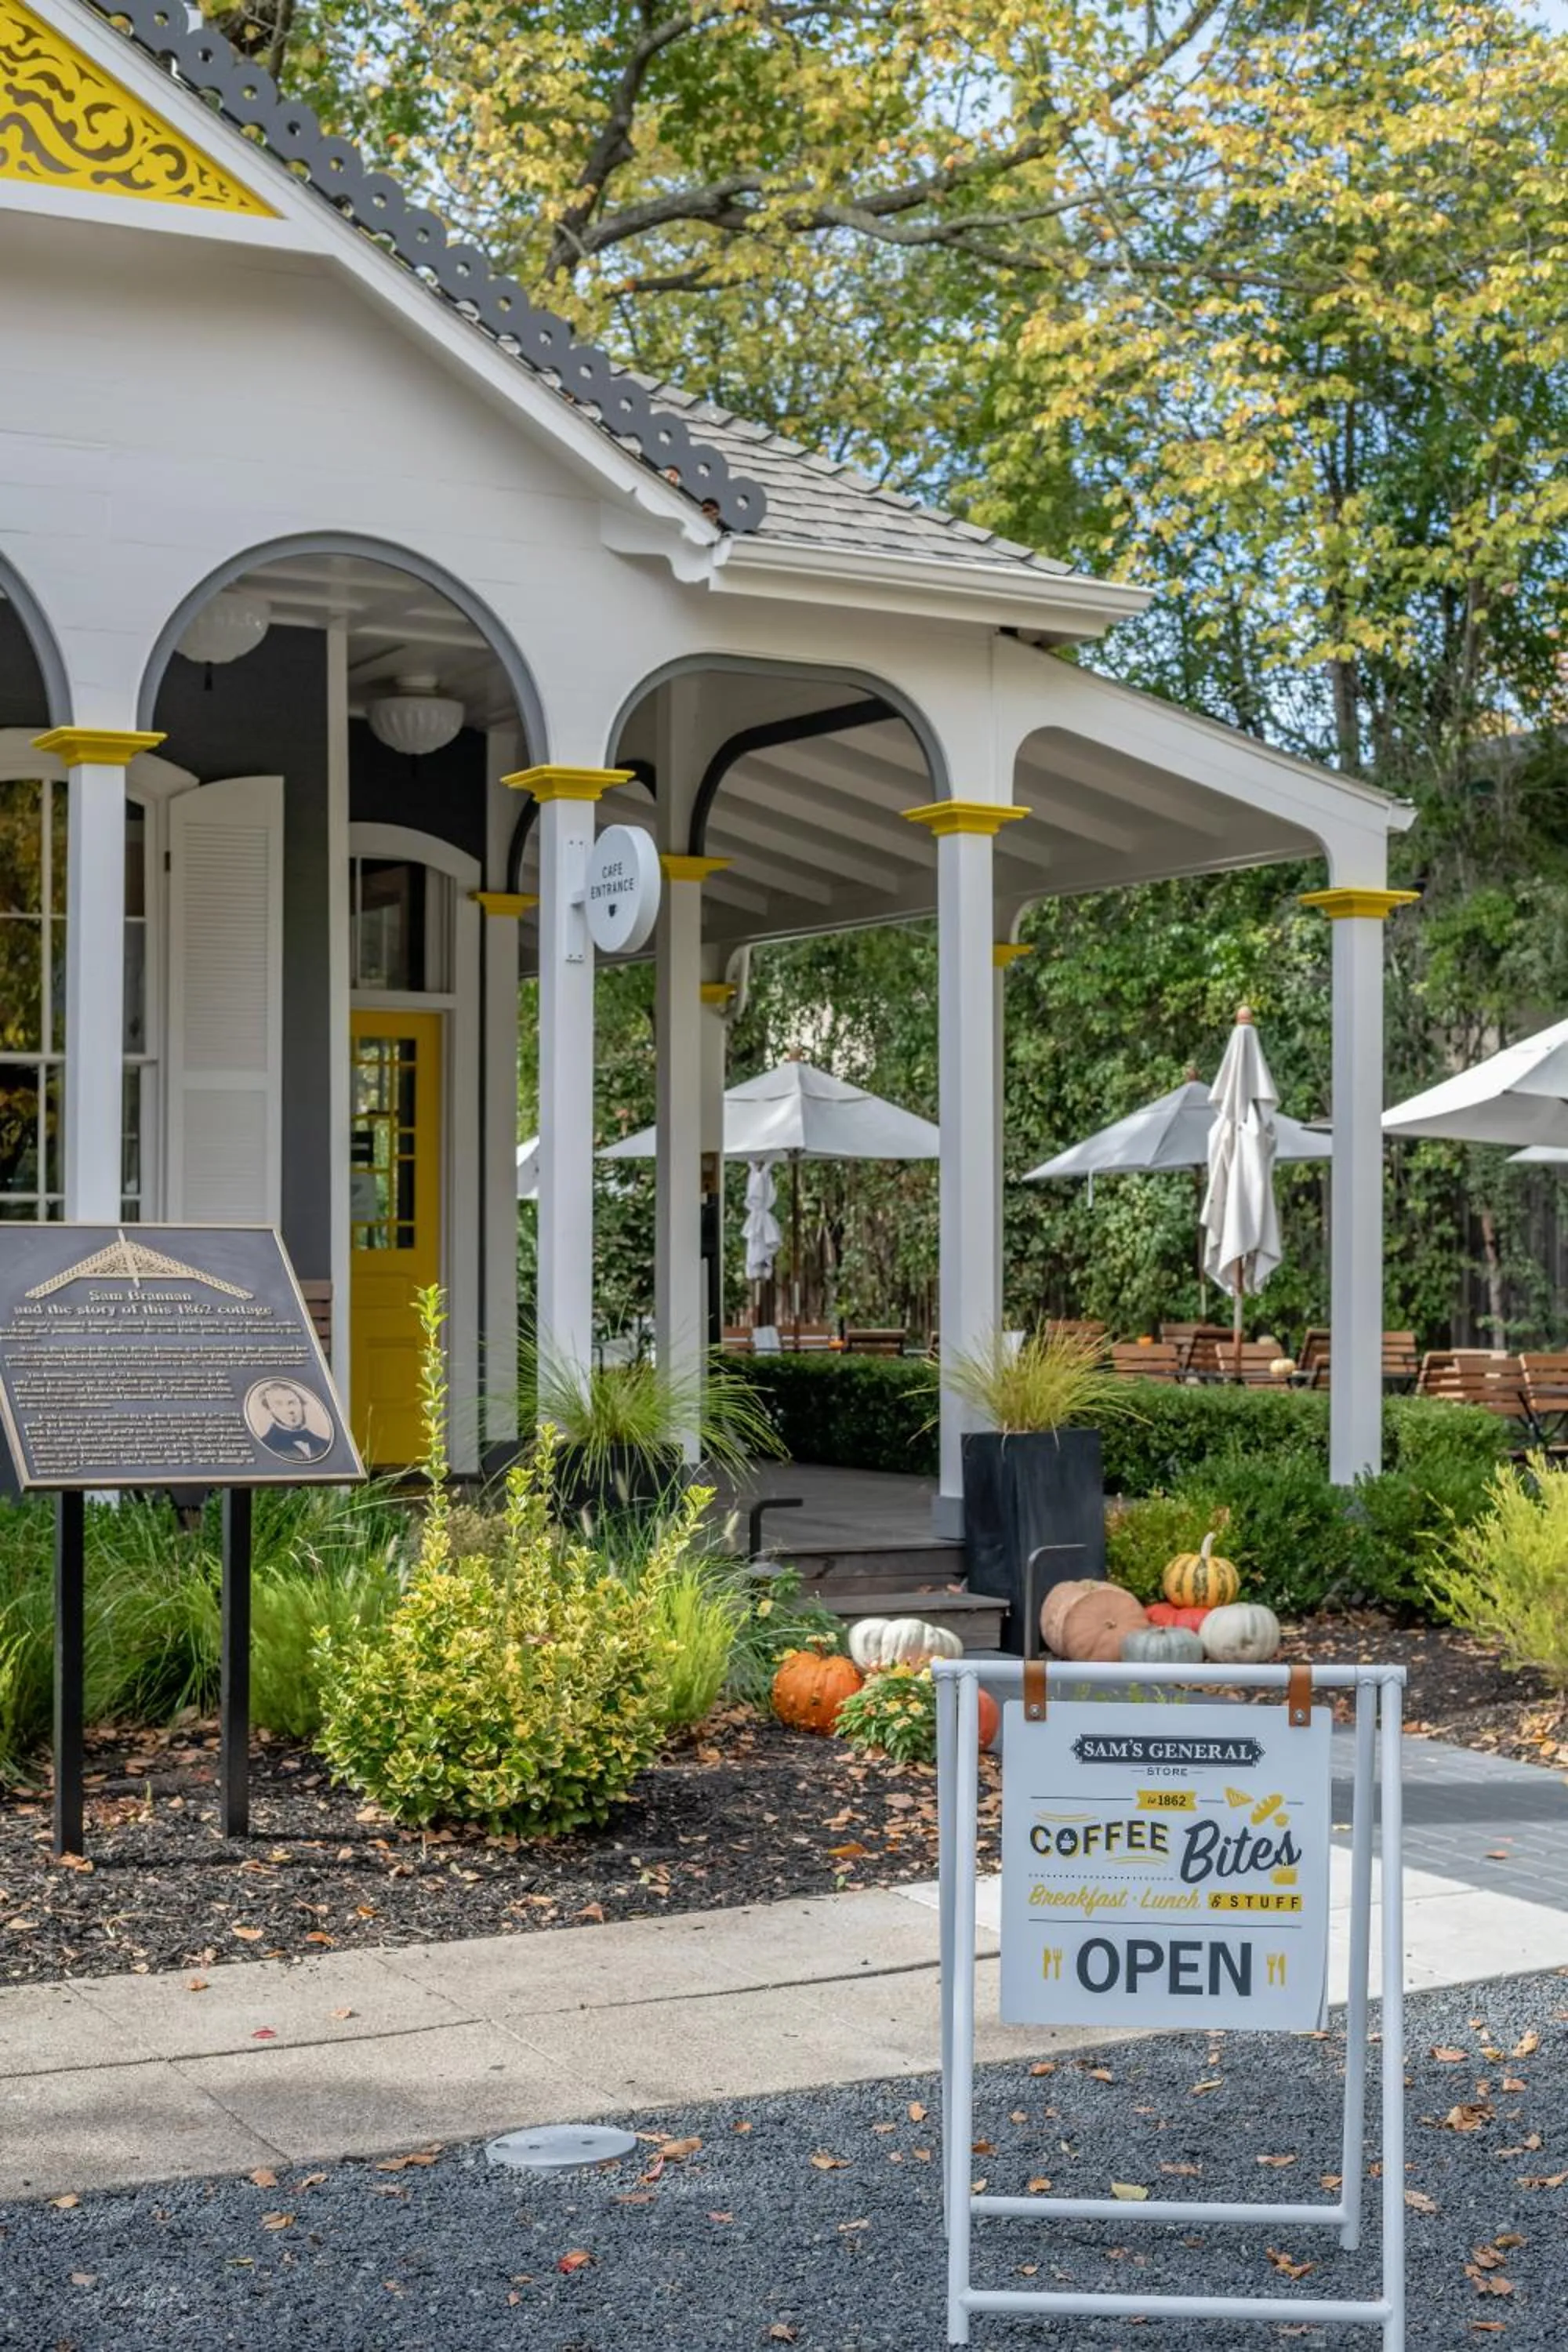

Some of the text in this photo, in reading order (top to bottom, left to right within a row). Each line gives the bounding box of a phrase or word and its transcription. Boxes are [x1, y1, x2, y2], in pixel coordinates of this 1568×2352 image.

[601, 862, 623, 879] CAFE
[590, 878, 634, 900] ENTRANCE
[89, 1290, 192, 1302] Sam Brannan
[13, 1303, 273, 1319] and the story of this 1862 cottage
[1083, 1739, 1253, 1761] SAM'S GENERAL
[1146, 1766, 1189, 1777] STORE
[1158, 1794, 1186, 1807] 1862
[1029, 1819, 1302, 1884] COFFEE Bites
[1028, 1882, 1301, 1917] Breakfast Lunch & STUFF
[1076, 1937, 1253, 1998] OPEN
